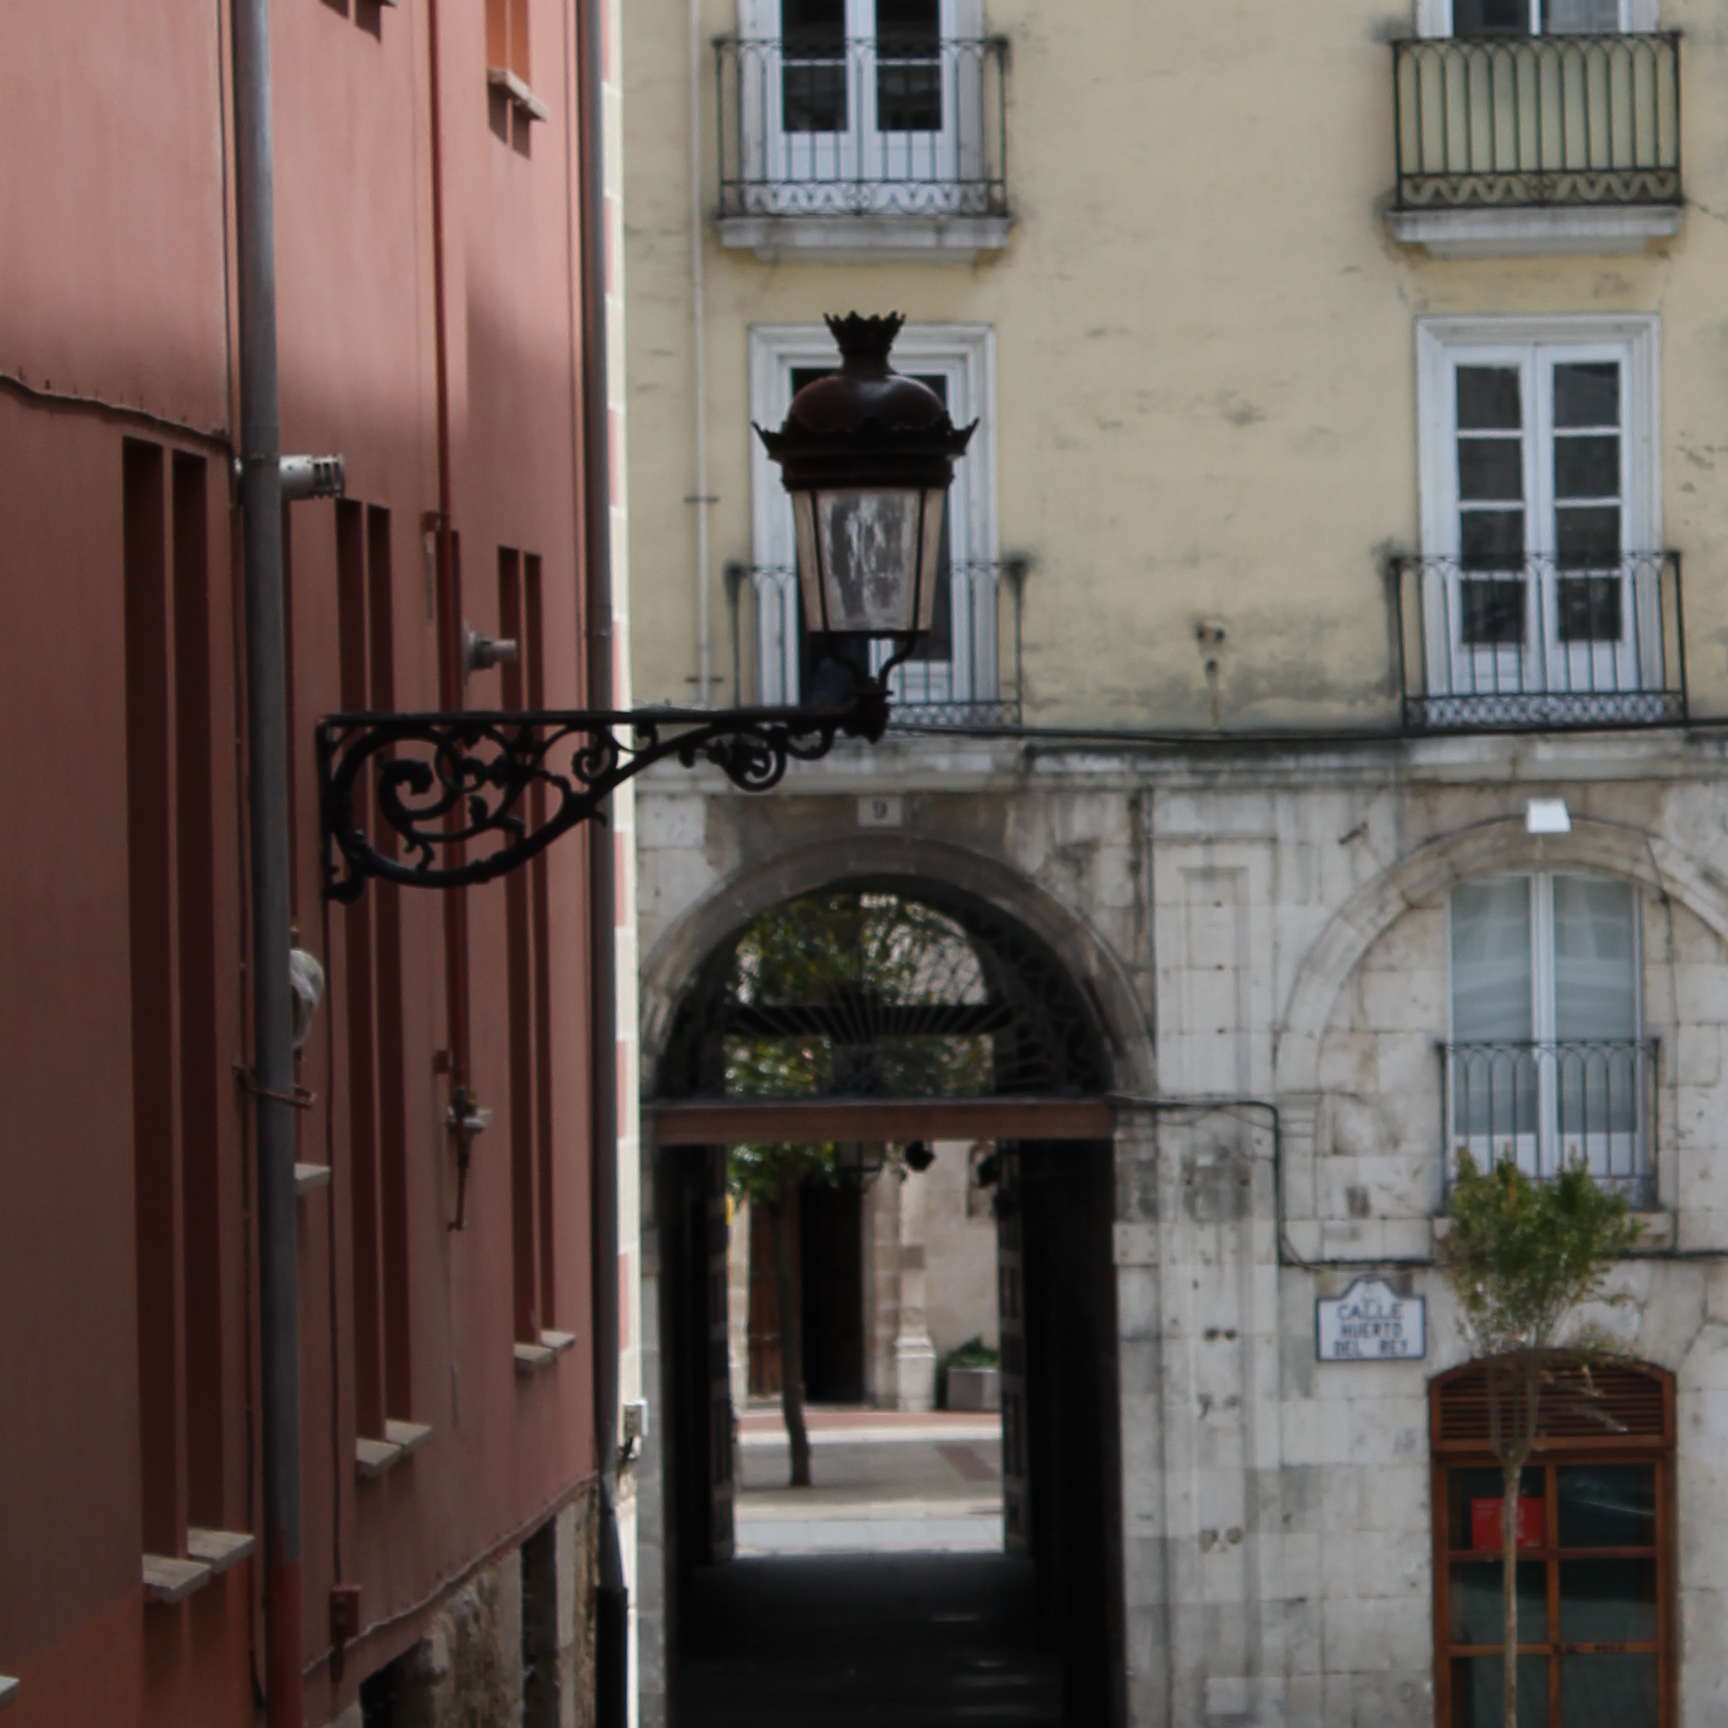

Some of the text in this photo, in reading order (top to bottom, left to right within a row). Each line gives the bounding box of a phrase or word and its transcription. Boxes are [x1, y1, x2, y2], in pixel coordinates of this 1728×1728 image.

[872, 799, 888, 820] 9
[1337, 1302, 1403, 1320] CALLE
[1340, 1321, 1404, 1338] HUERTO
[1334, 1338, 1409, 1357] DEL REY
